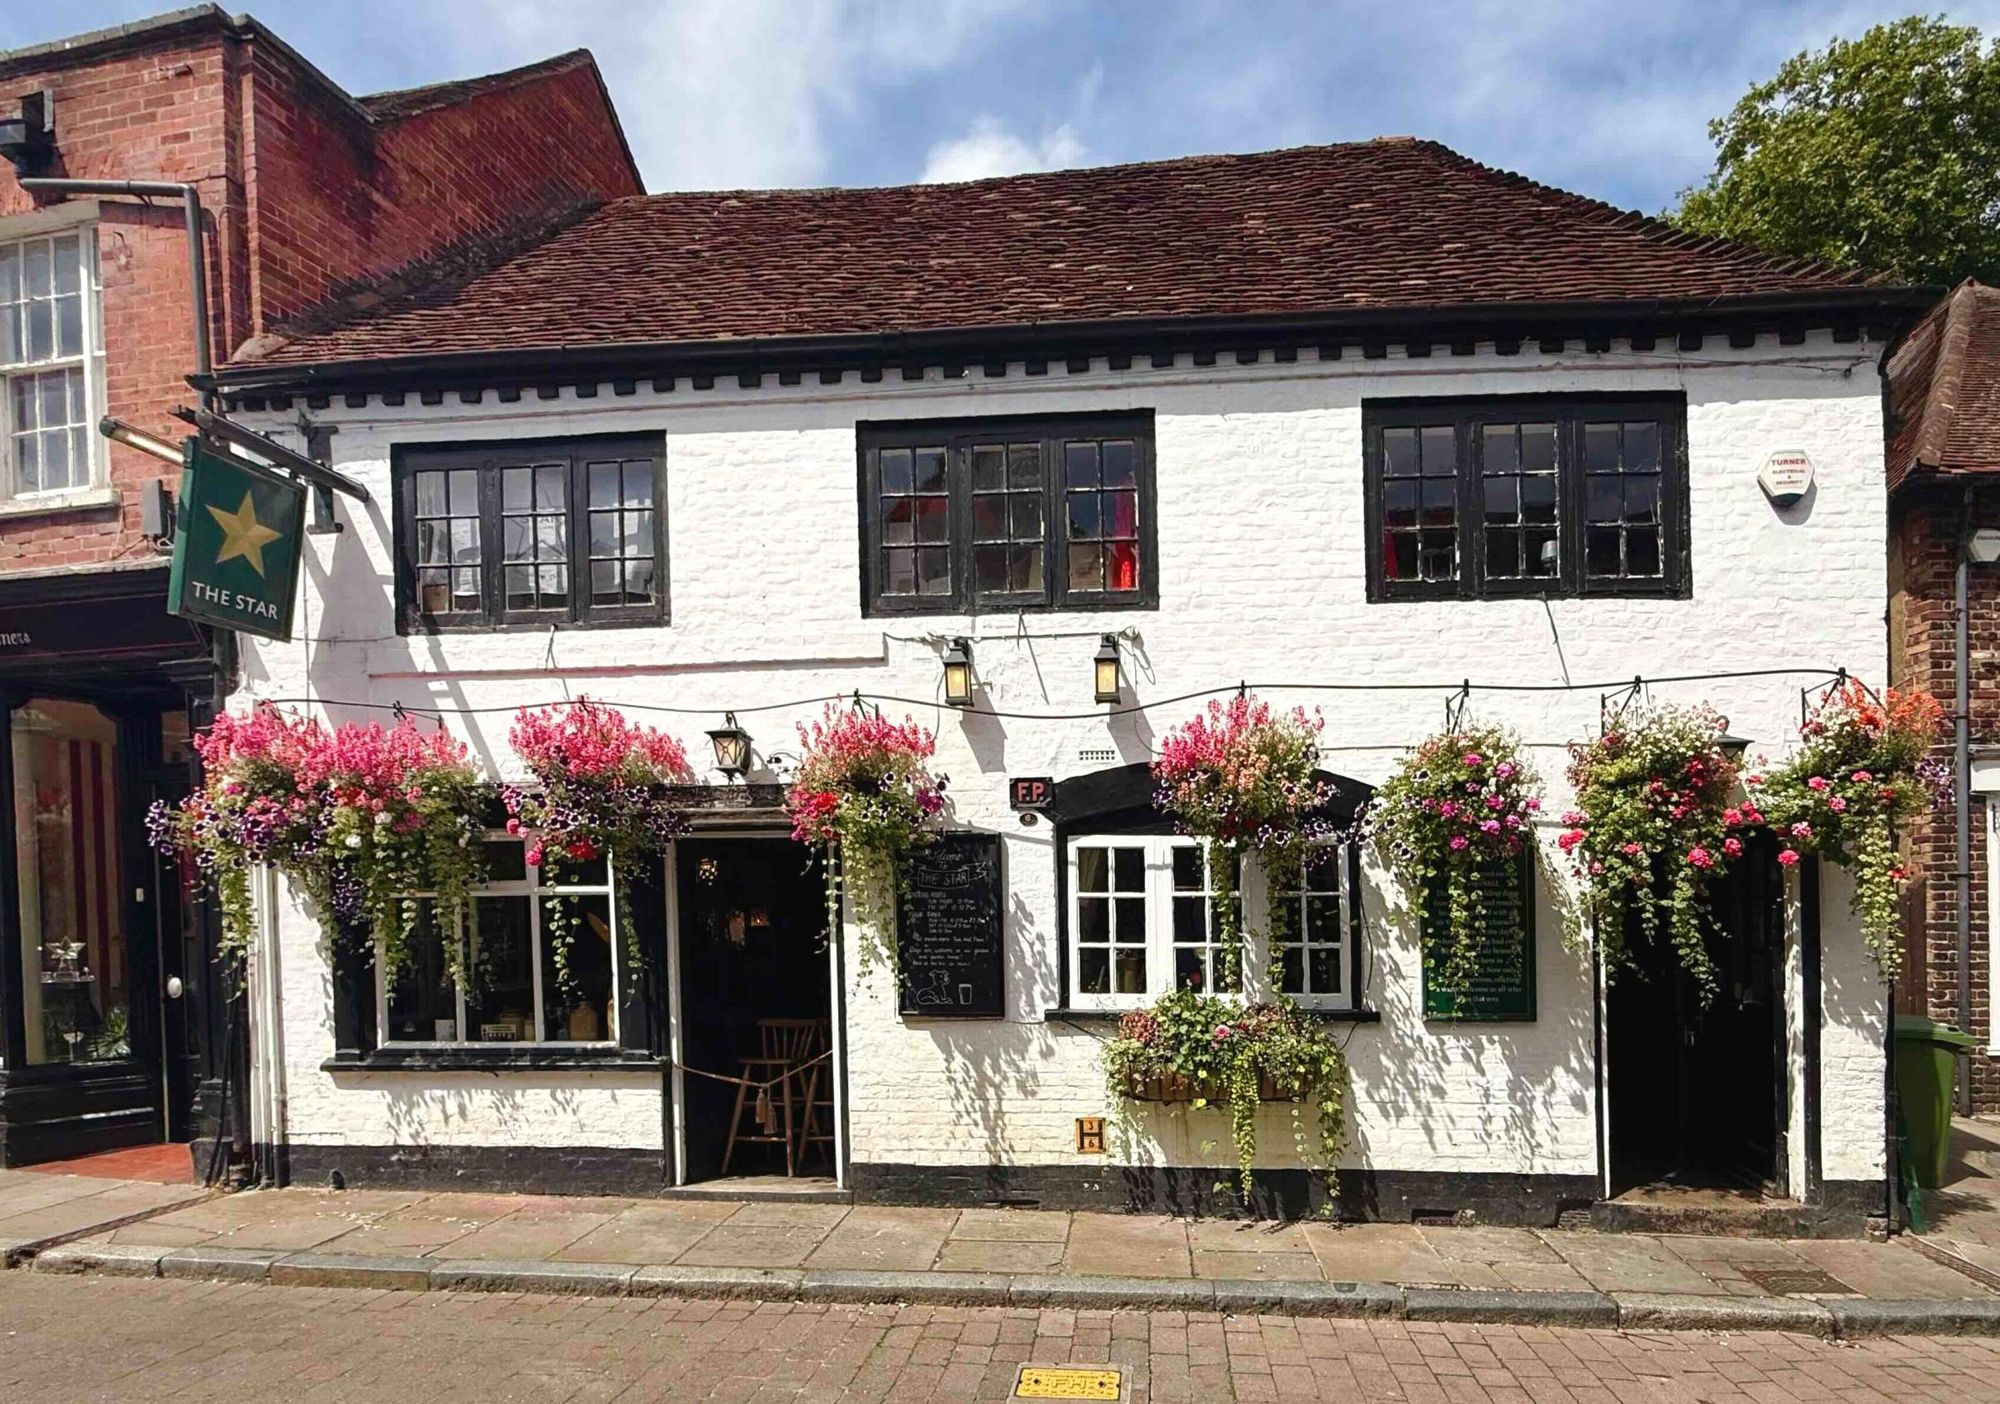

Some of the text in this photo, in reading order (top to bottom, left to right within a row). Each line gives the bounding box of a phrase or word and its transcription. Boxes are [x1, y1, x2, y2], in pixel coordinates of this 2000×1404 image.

[1771, 458, 1806, 466] TURNER
[192, 581, 278, 620] THE STAR
[919, 872, 967, 886] THE STAR
[1088, 1139, 1095, 1148] 6
